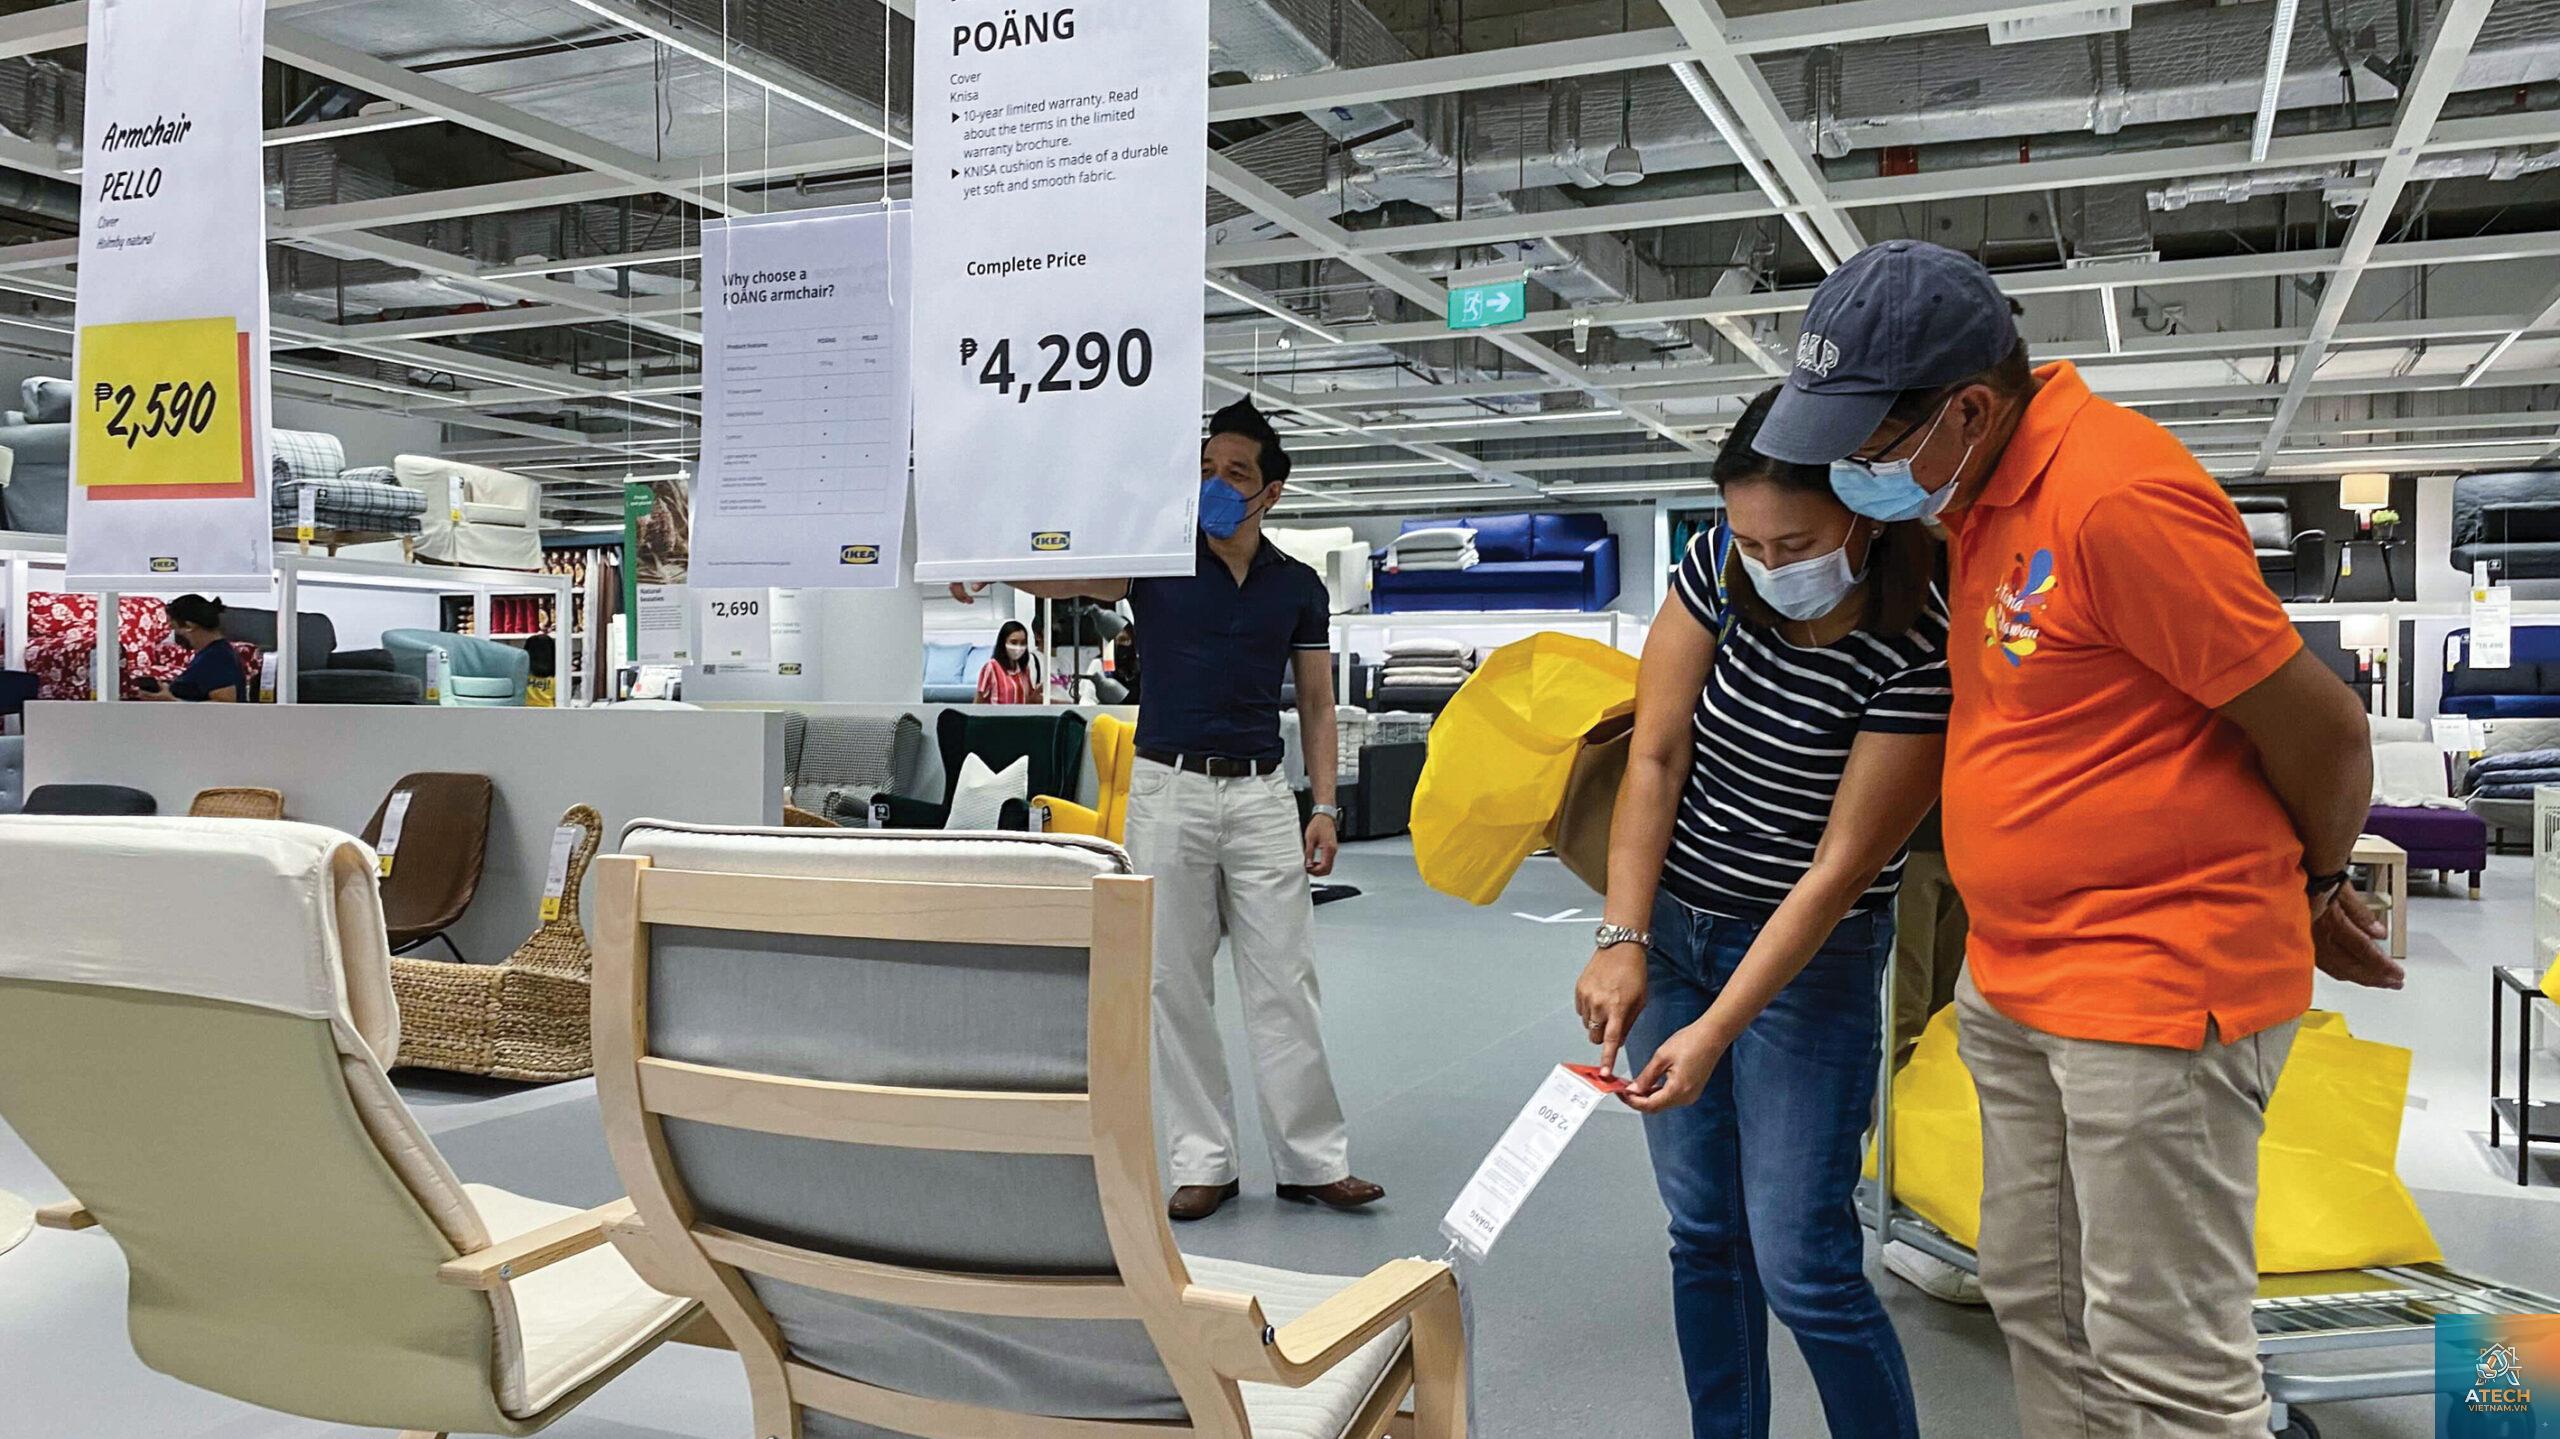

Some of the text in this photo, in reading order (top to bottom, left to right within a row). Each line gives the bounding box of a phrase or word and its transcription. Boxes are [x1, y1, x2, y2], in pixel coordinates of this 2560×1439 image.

[953, 8, 1074, 56] POÄNG
[950, 72, 981, 85] Cover
[950, 91, 979, 102] Knisa
[964, 87, 1138, 123] 10-year limited warranty. Read
[102, 112, 191, 152] Armchair
[963, 107, 1135, 140] about the terms in the limited
[963, 137, 1072, 158] warranty brochure.
[963, 143, 1168, 177] KNISA cushion is made of a durable
[100, 167, 161, 203] PELLO
[963, 169, 1116, 201] yet soft and smooth fabric.
[752, 270, 796, 284] choose
[799, 270, 807, 280] a
[967, 252, 1086, 277] Complete Price
[770, 284, 834, 302] armchair?
[960, 328, 1152, 403] ₱4,290
[94, 380, 217, 450] ₱2,590
[842, 549, 878, 561] IKEA
[1034, 535, 1068, 547] IKEA
